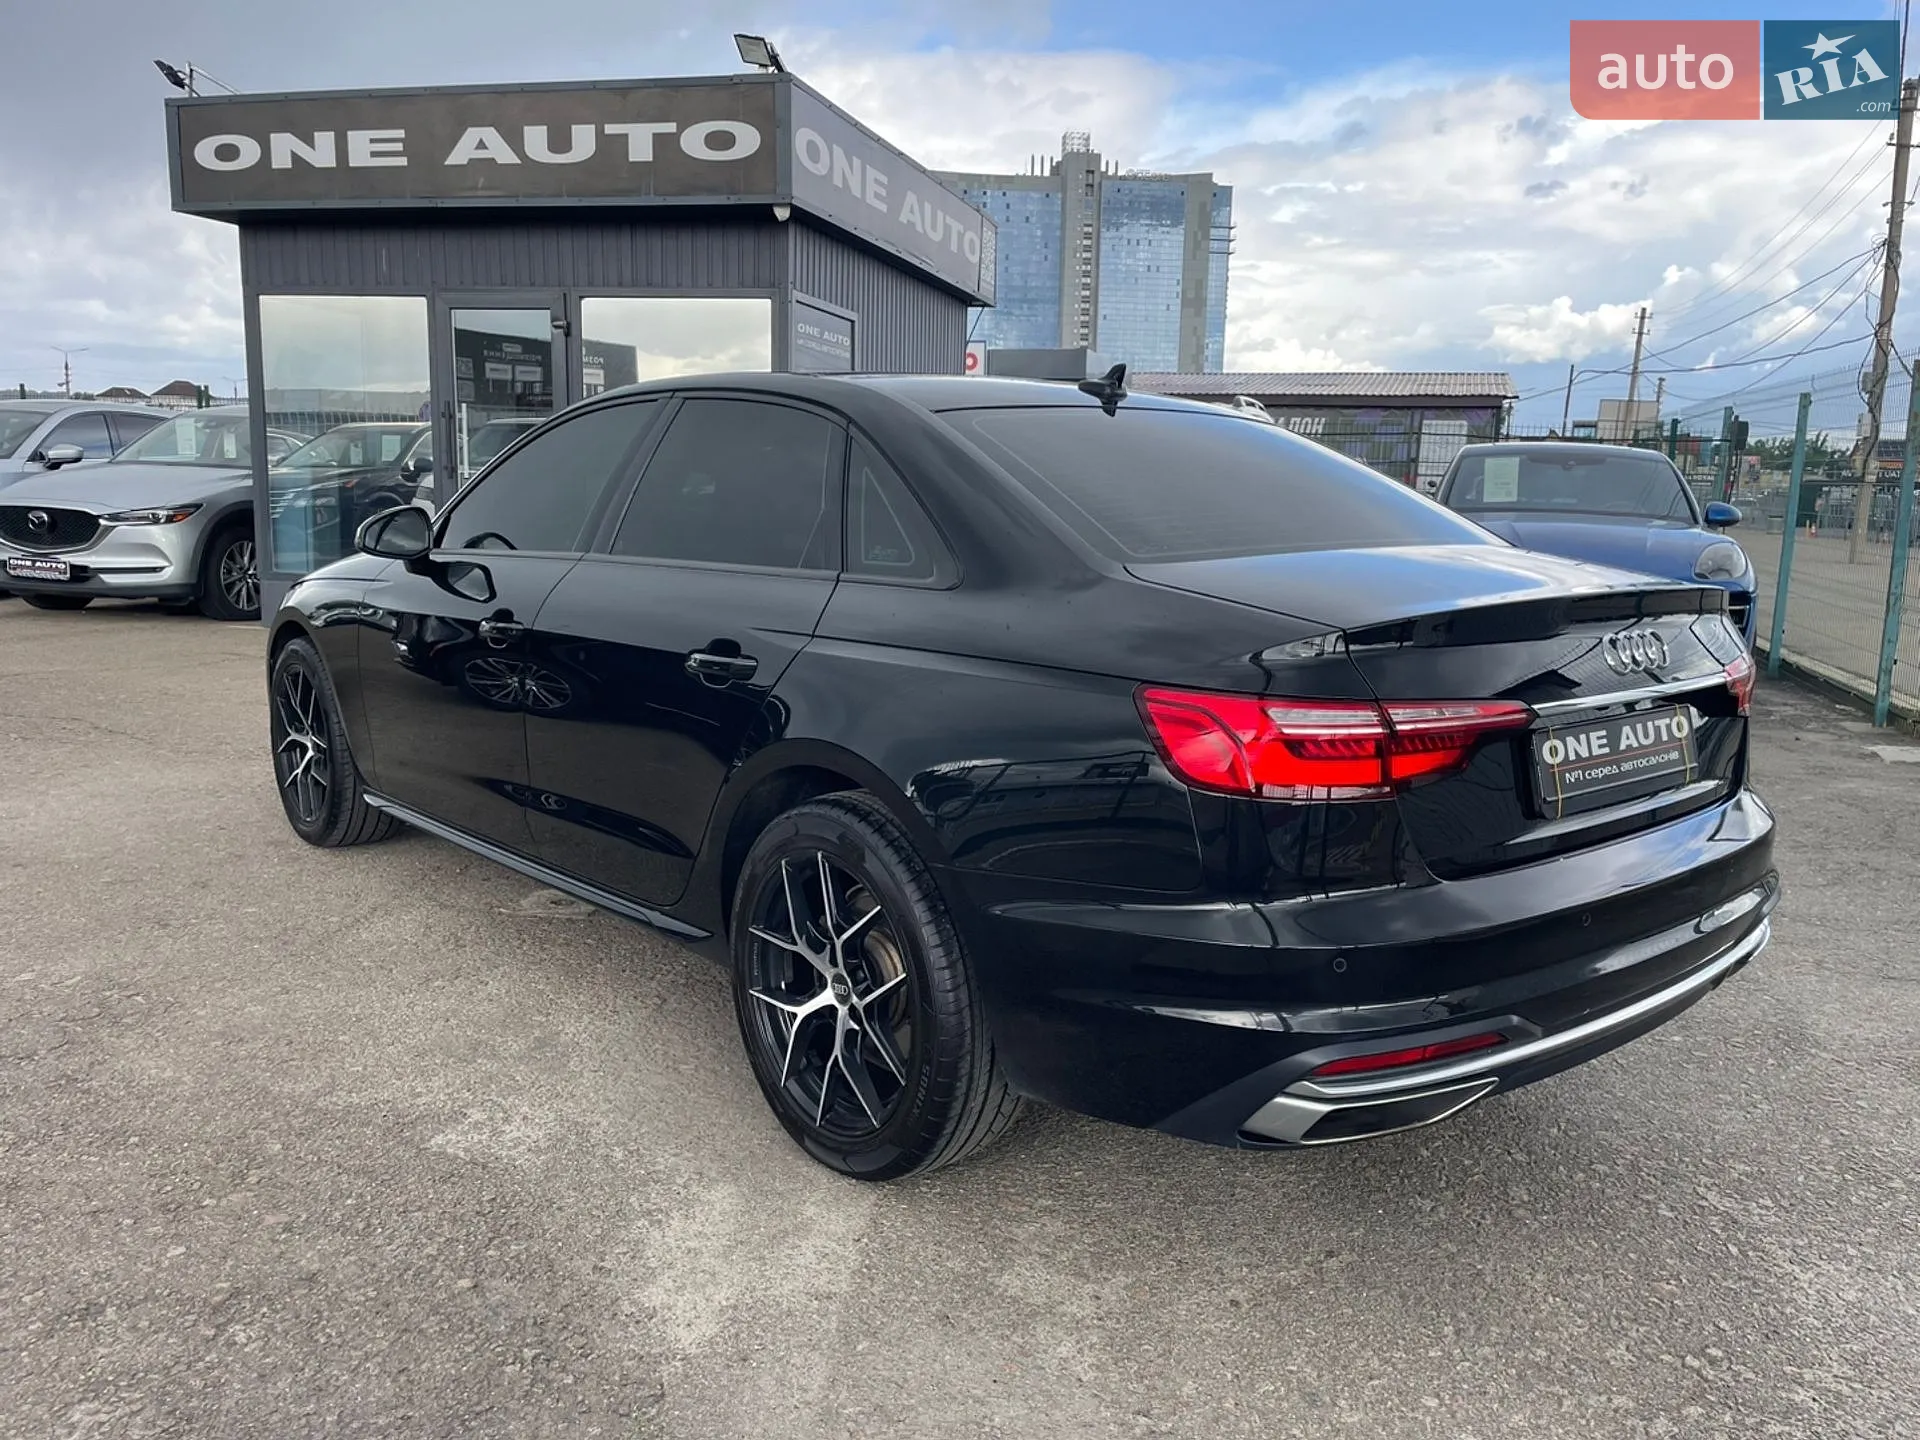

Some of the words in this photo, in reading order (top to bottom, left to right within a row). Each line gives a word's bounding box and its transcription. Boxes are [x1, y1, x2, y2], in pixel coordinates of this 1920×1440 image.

[193, 128, 408, 171] ONE
[444, 120, 761, 165] AUTO
[794, 126, 889, 213] ONE
[899, 190, 980, 264] AUTO
[797, 323, 821, 337] ONE
[823, 331, 850, 346] AUTO
[9, 558, 32, 567] ONE
[35, 561, 66, 569] AUTO
[1542, 730, 1610, 765] ONE
[1619, 715, 1690, 750] AUTO
[1585, 763, 1619, 780] серед
[1620, 749, 1680, 772] автосалонів
